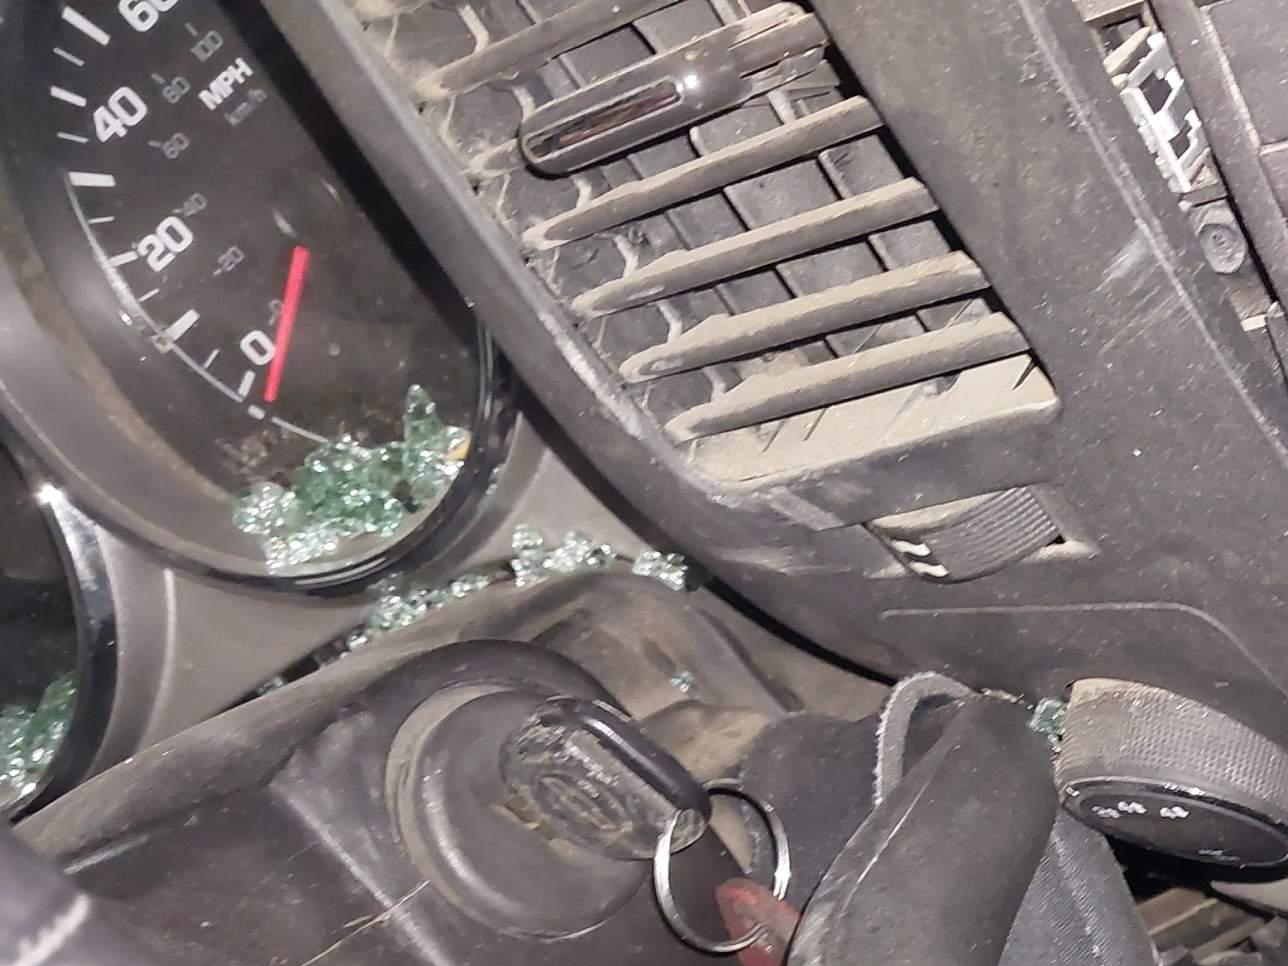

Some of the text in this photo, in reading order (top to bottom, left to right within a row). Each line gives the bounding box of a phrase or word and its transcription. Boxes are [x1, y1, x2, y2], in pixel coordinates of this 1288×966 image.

[118, 0, 179, 32] 6
[199, 57, 253, 110] MPH
[93, 87, 147, 143] 40
[137, 216, 193, 272] 20
[240, 330, 276, 366] 0
